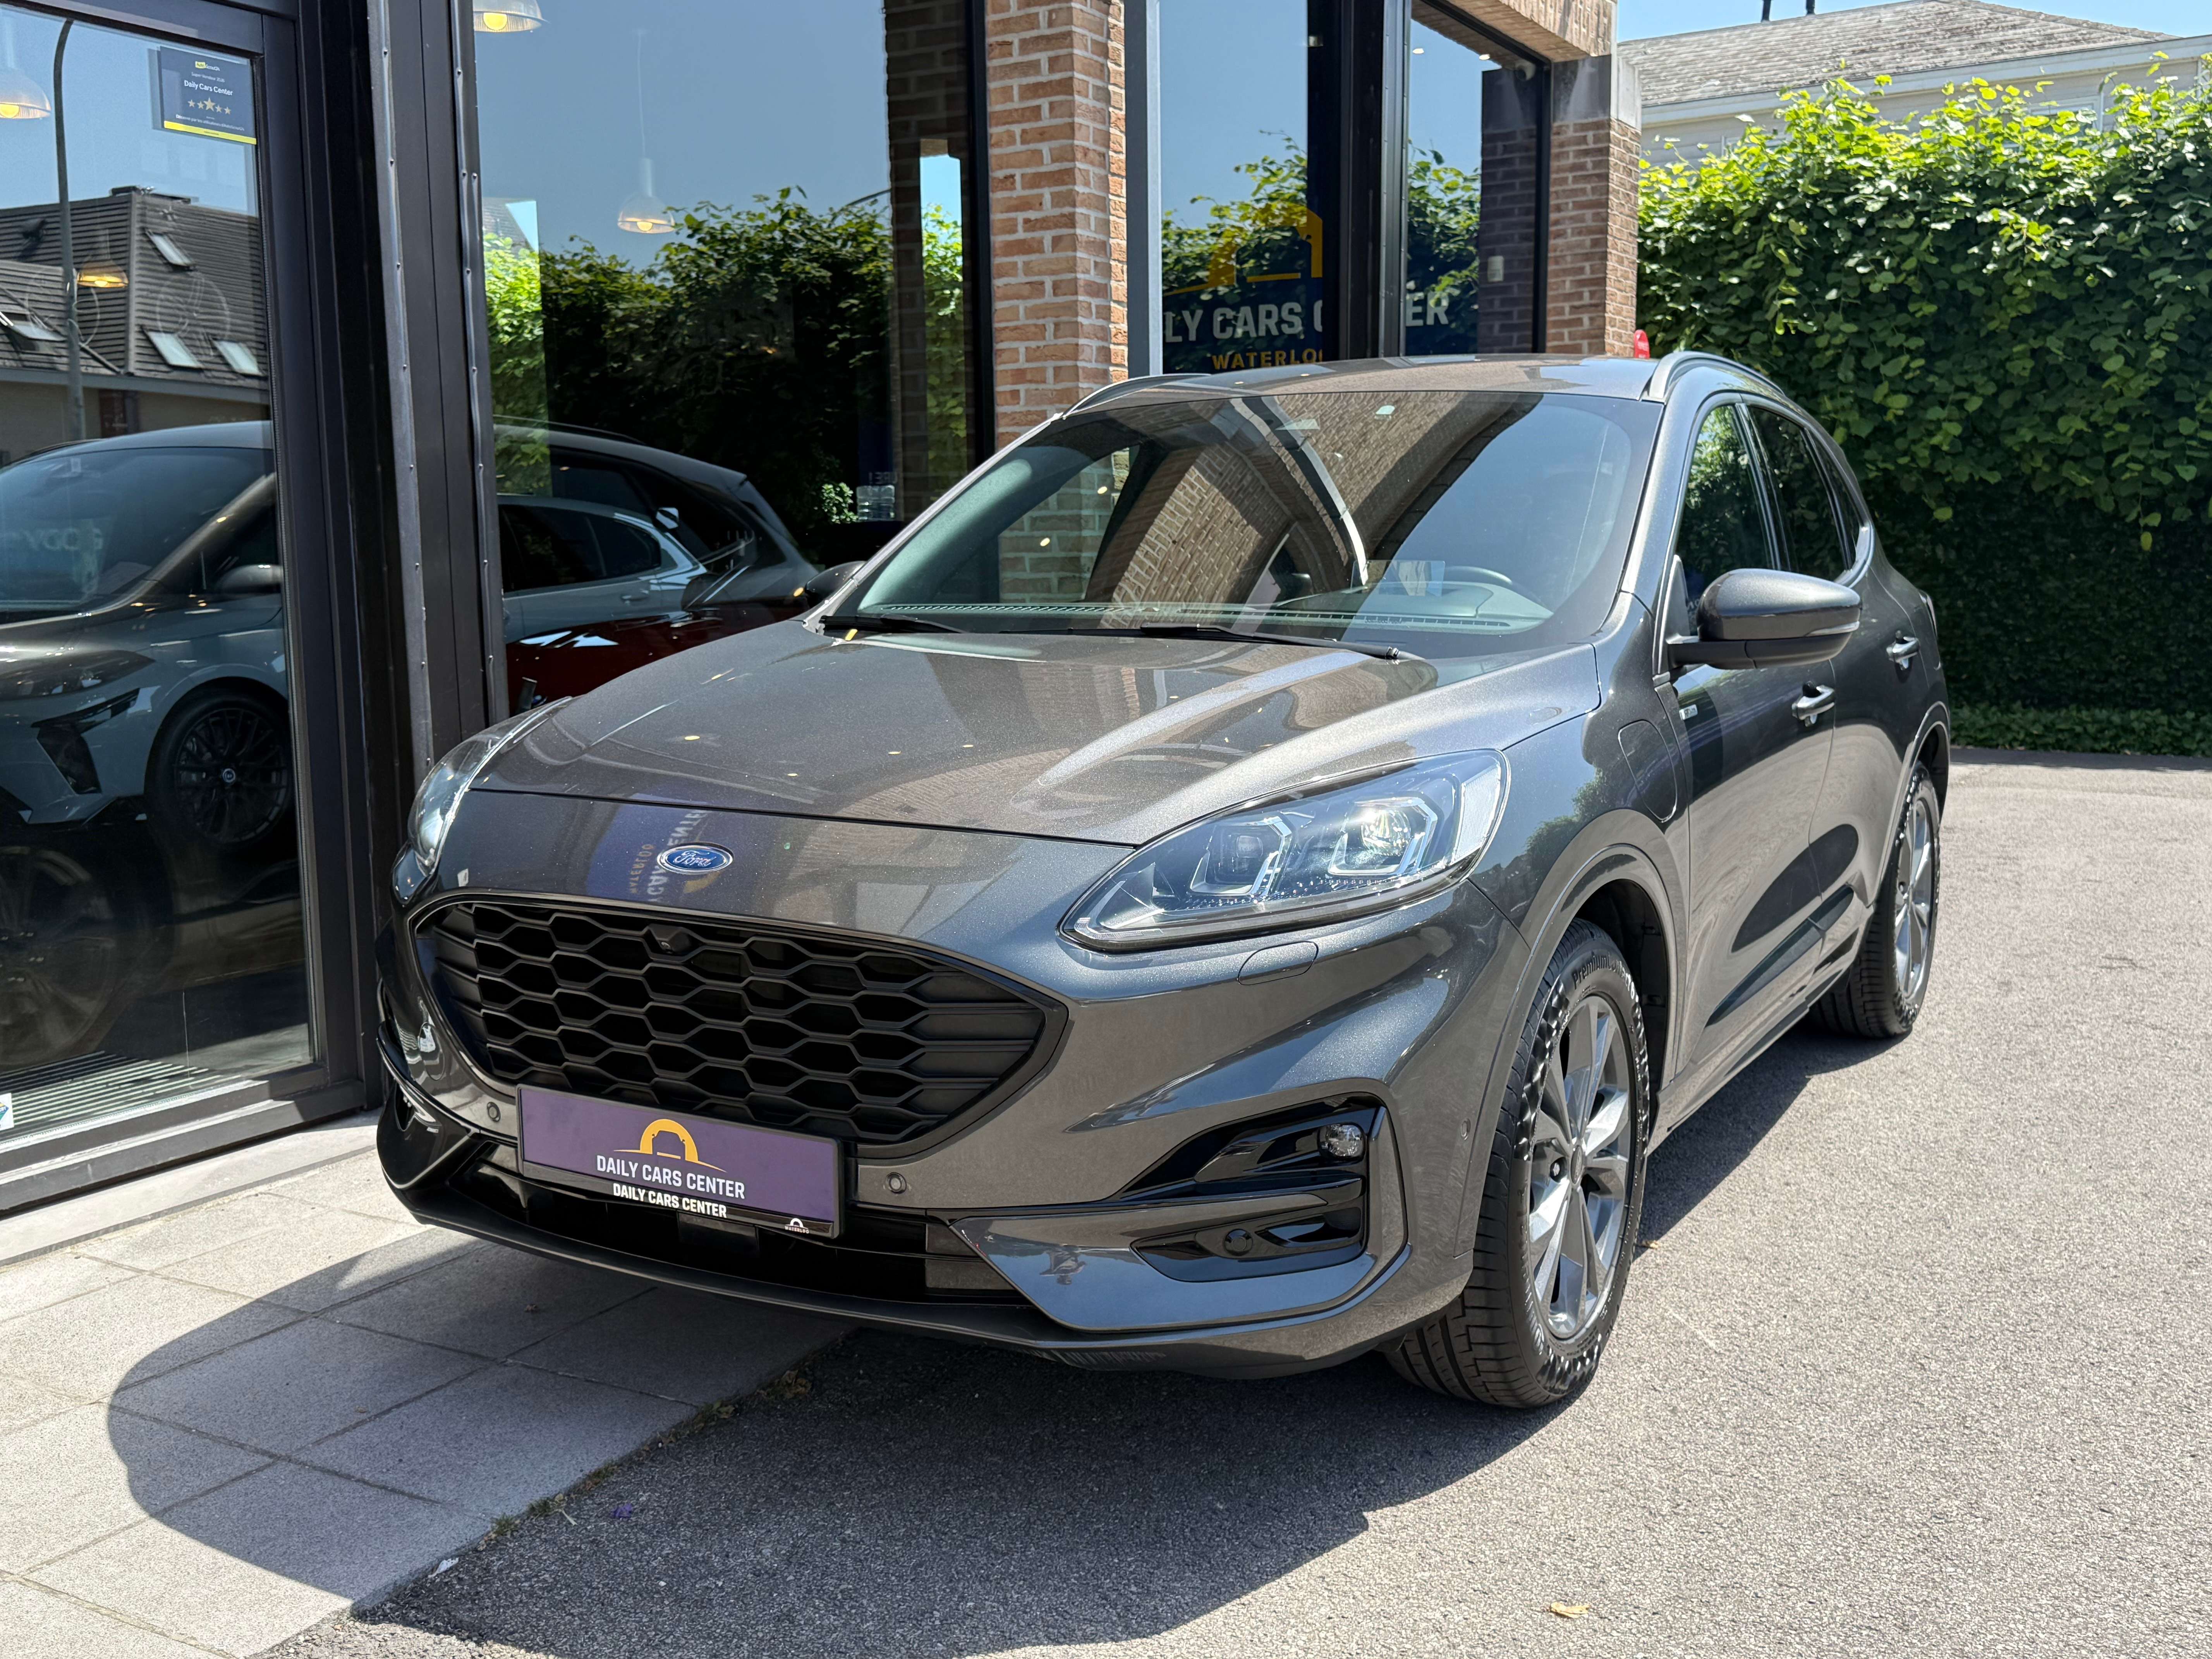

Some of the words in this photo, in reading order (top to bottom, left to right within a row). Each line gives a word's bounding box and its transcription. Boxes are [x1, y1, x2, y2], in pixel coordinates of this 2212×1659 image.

[184, 80, 198, 90] Daily
[199, 83, 213, 92] Cars
[213, 86, 233, 95] Center
[1213, 302, 1302, 339] CARS
[673, 850, 716, 867] Ford
[597, 1155, 638, 1178] DAILY
[642, 1164, 682, 1187] CARS
[687, 1173, 745, 1199] CENTER
[613, 1183, 646, 1202] DAILY
[648, 1190, 680, 1209] CARS
[682, 1197, 727, 1218] CENTER
[785, 1225, 810, 1234] WATERLOO
